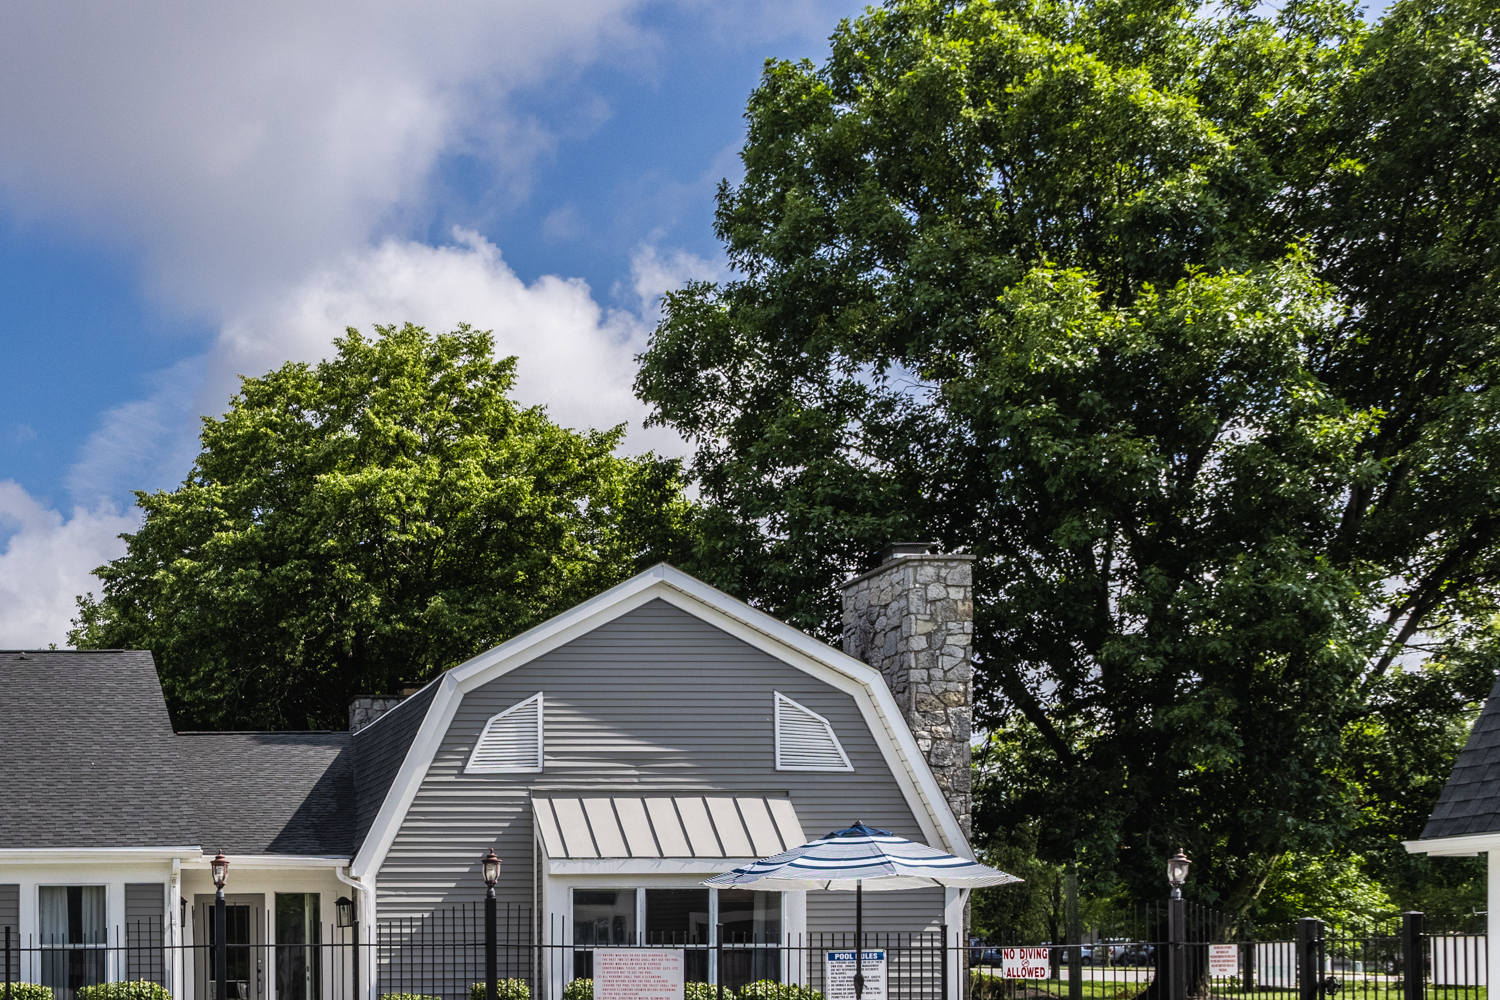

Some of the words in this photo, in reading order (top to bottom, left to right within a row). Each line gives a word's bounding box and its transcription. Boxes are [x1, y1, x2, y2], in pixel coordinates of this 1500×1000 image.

[1004, 948, 1015, 959] NO
[1020, 948, 1048, 959] DIVING
[1006, 967, 1046, 978] ALLOWED
